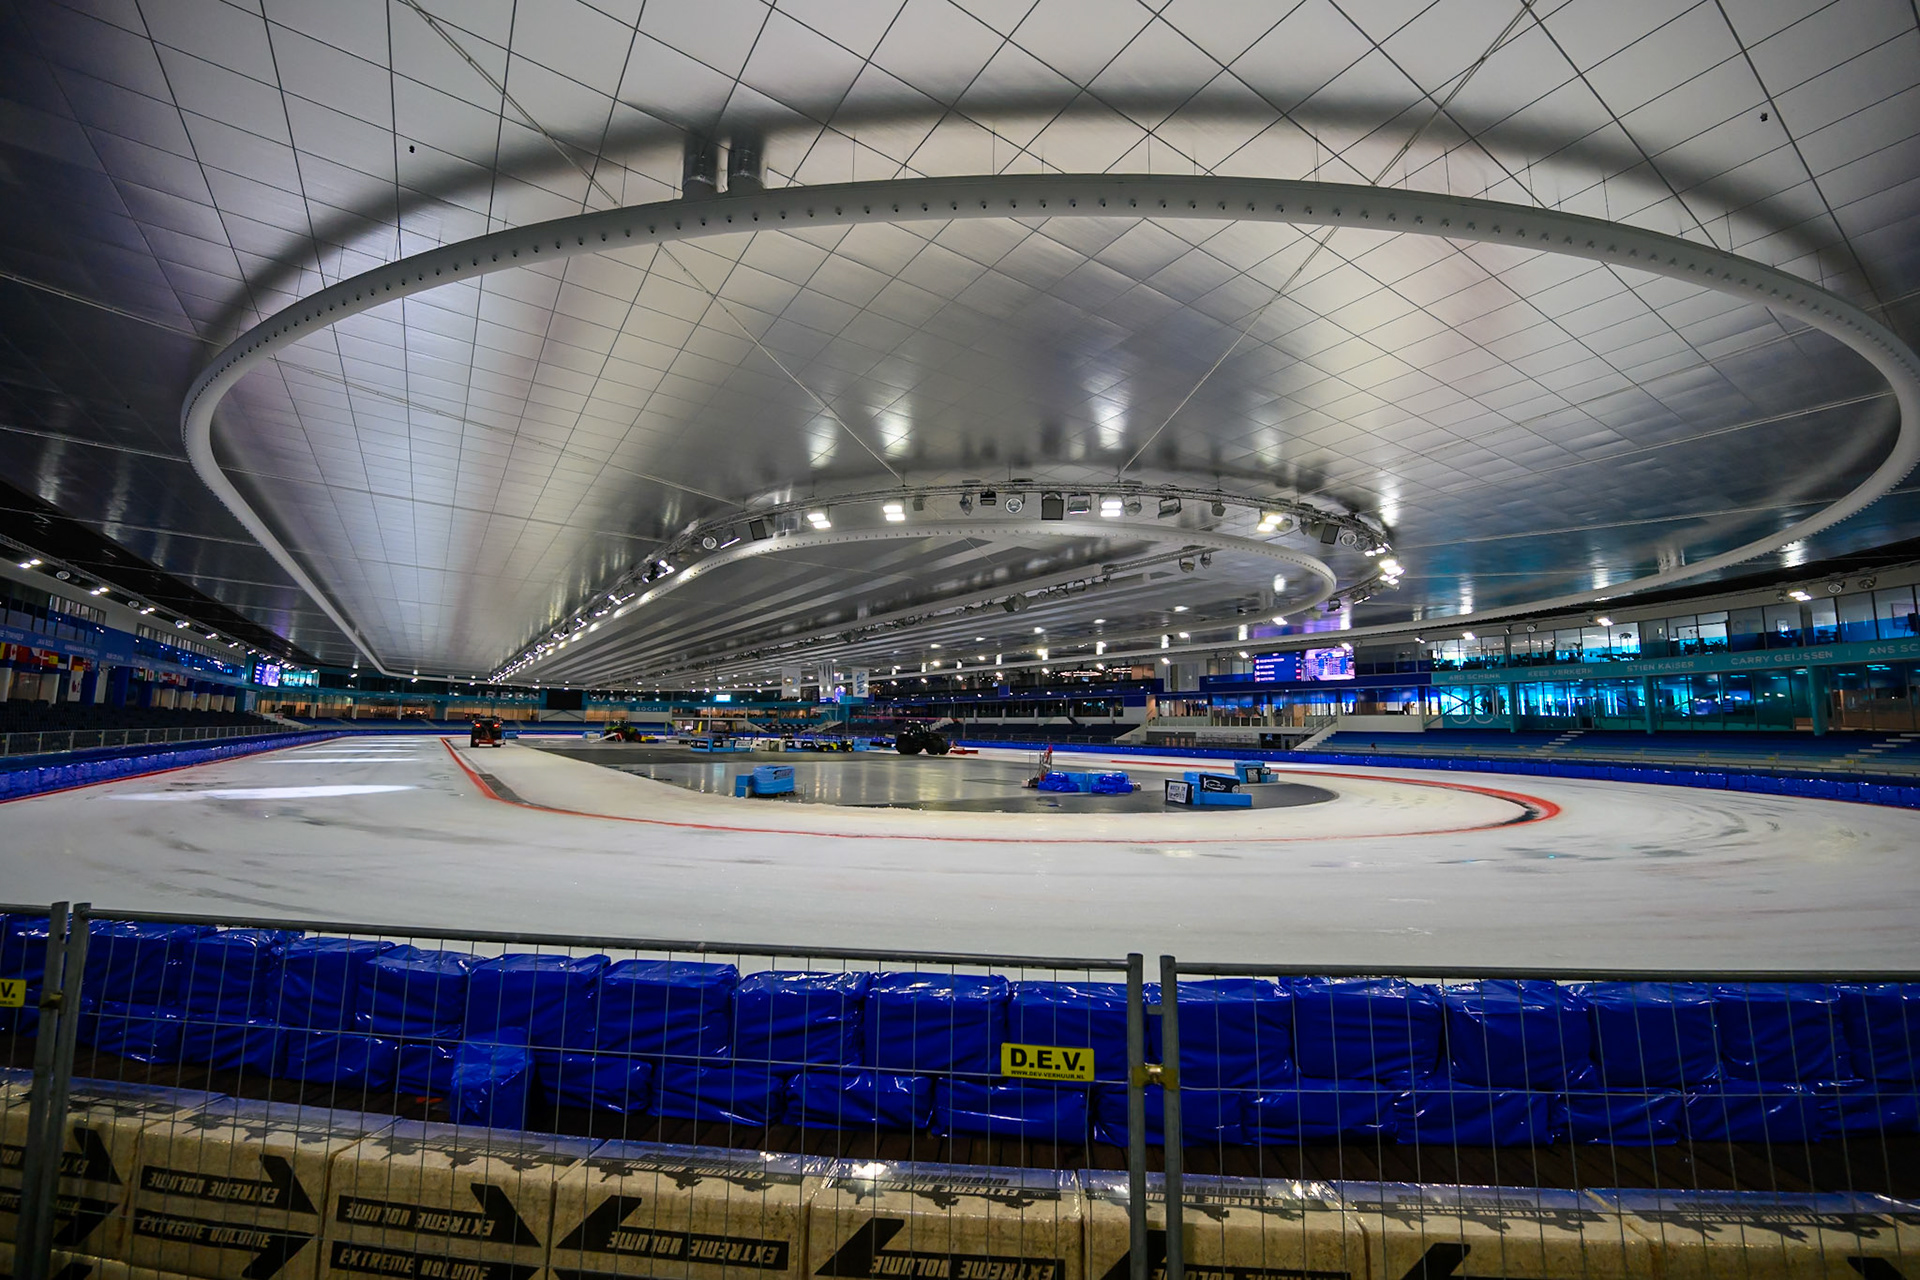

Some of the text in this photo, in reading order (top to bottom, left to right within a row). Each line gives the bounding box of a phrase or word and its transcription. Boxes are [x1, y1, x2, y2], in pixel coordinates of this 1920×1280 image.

[1731, 651, 1833, 665] CARRY GEIJSSEN
[1868, 645, 1895, 656] ANS
[1552, 668, 1593, 676] VERKERK
[1627, 661, 1695, 672] STIEN KAISER
[477, 690, 540, 699] IREEN
[1010, 1047, 1085, 1071] D.E.V.
[148, 1172, 280, 1204] EXTREME VOLUME
[940, 1184, 1020, 1197] EXTREME
[1204, 1196, 1284, 1208] EXTREME
[345, 1203, 495, 1236] EXTREME VOLUME
[139, 1216, 271, 1248] EXTREME VOLUME
[607, 1231, 780, 1264] EXTREME VOLUME
[338, 1248, 491, 1280] EXTREME VOLUME
[869, 1255, 951, 1279] VOLUME
